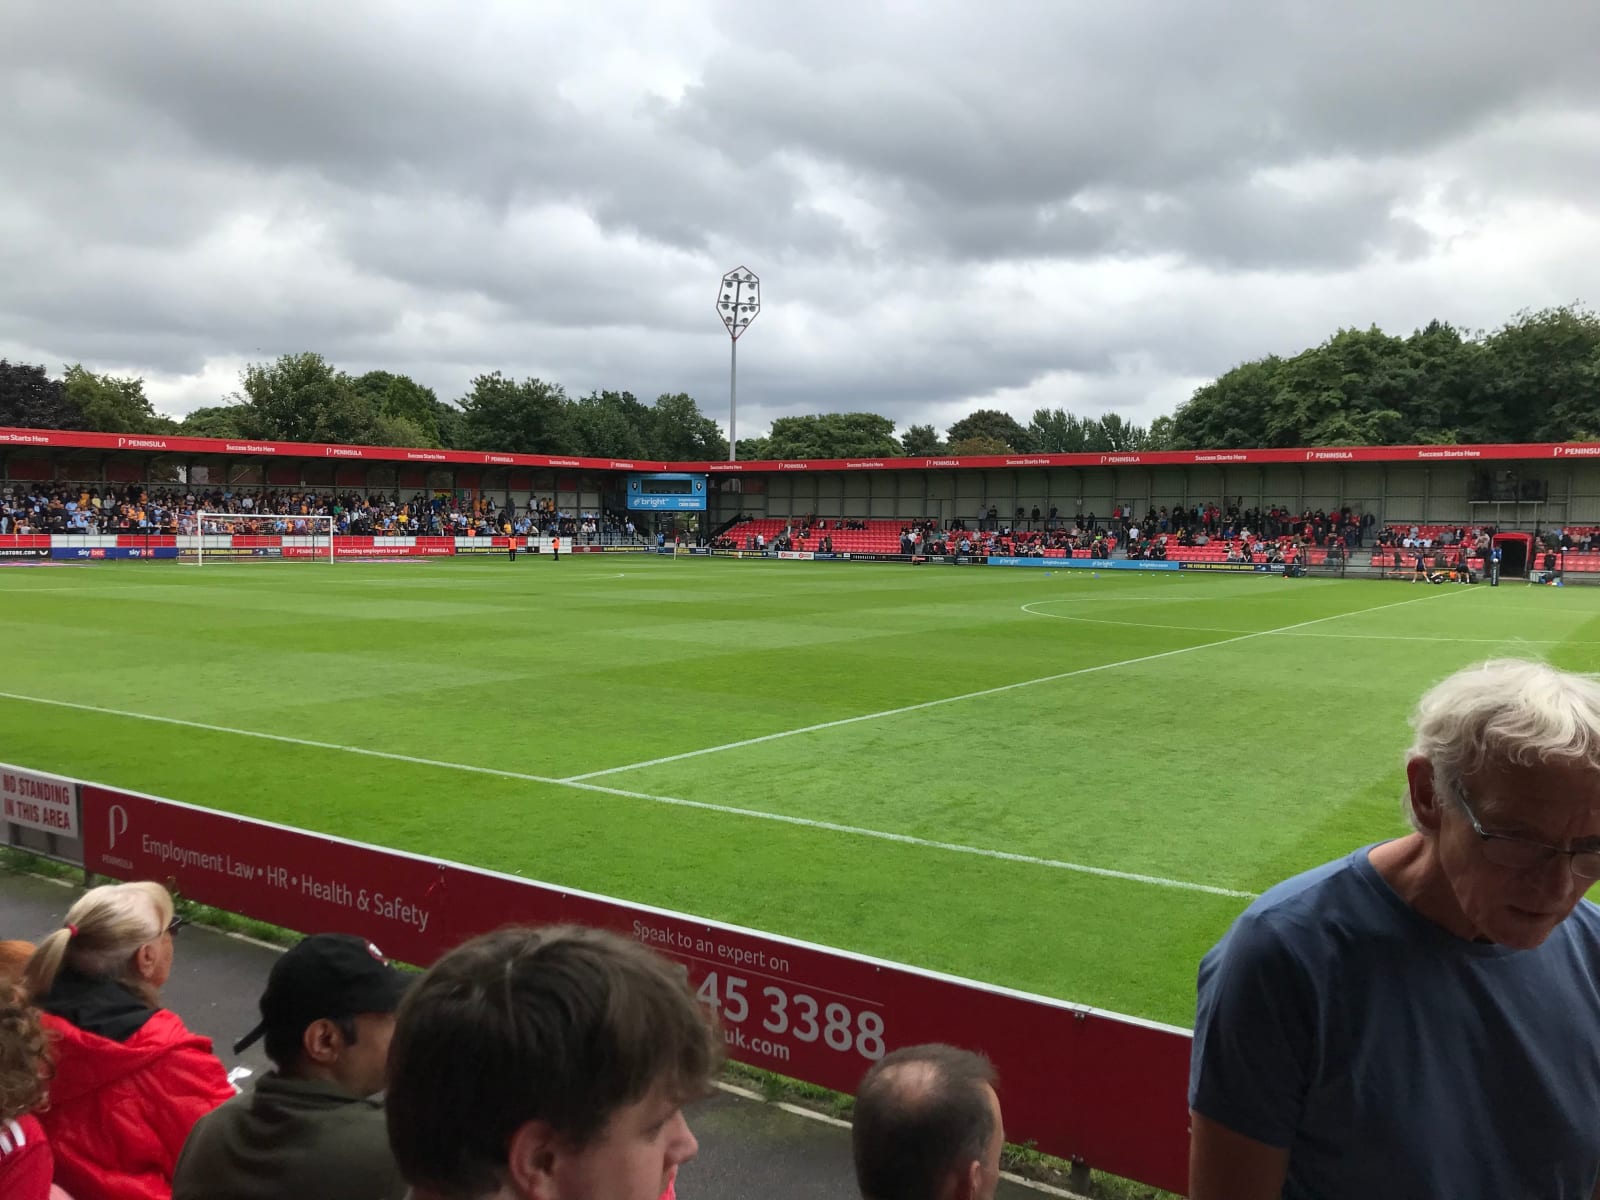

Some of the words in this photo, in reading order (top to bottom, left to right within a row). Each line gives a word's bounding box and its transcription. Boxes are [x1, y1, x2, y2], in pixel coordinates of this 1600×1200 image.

[10, 434, 32, 442] Starts
[32, 435, 49, 443] Here
[128, 439, 167, 449] PENINSULA
[226, 443, 247, 451] Success
[333, 448, 363, 457] PENINSULA
[1315, 451, 1353, 459] PENINSULA
[1418, 450, 1444, 458] Success
[1444, 450, 1464, 458] Starts
[1464, 449, 1481, 457] Here
[1564, 447, 1600, 455] PENINSU
[1108, 455, 1140, 463] PENINSULA
[641, 497, 666, 508] bright
[78, 549, 90, 557] sky
[129, 549, 140, 557] sky
[337, 547, 363, 555] Protecting
[3, 773, 17, 794] NO
[19, 777, 70, 806] STANDING
[4, 797, 15, 817] IN
[16, 801, 40, 823] THIS
[43, 807, 71, 830] AREA
[142, 834, 224, 873] Employment
[226, 855, 255, 882] Law
[267, 865, 288, 890] HR
[302, 874, 353, 907] Health
[356, 889, 370, 912] &
[374, 893, 429, 933] Safety
[633, 919, 675, 945] Speak
[678, 932, 692, 949] to
[696, 939, 714, 956] an
[717, 943, 766, 968] expert
[769, 956, 789, 974] on
[696, 971, 749, 1023] 45
[762, 985, 886, 1061] 3388
[724, 1028, 790, 1062] uk.com
